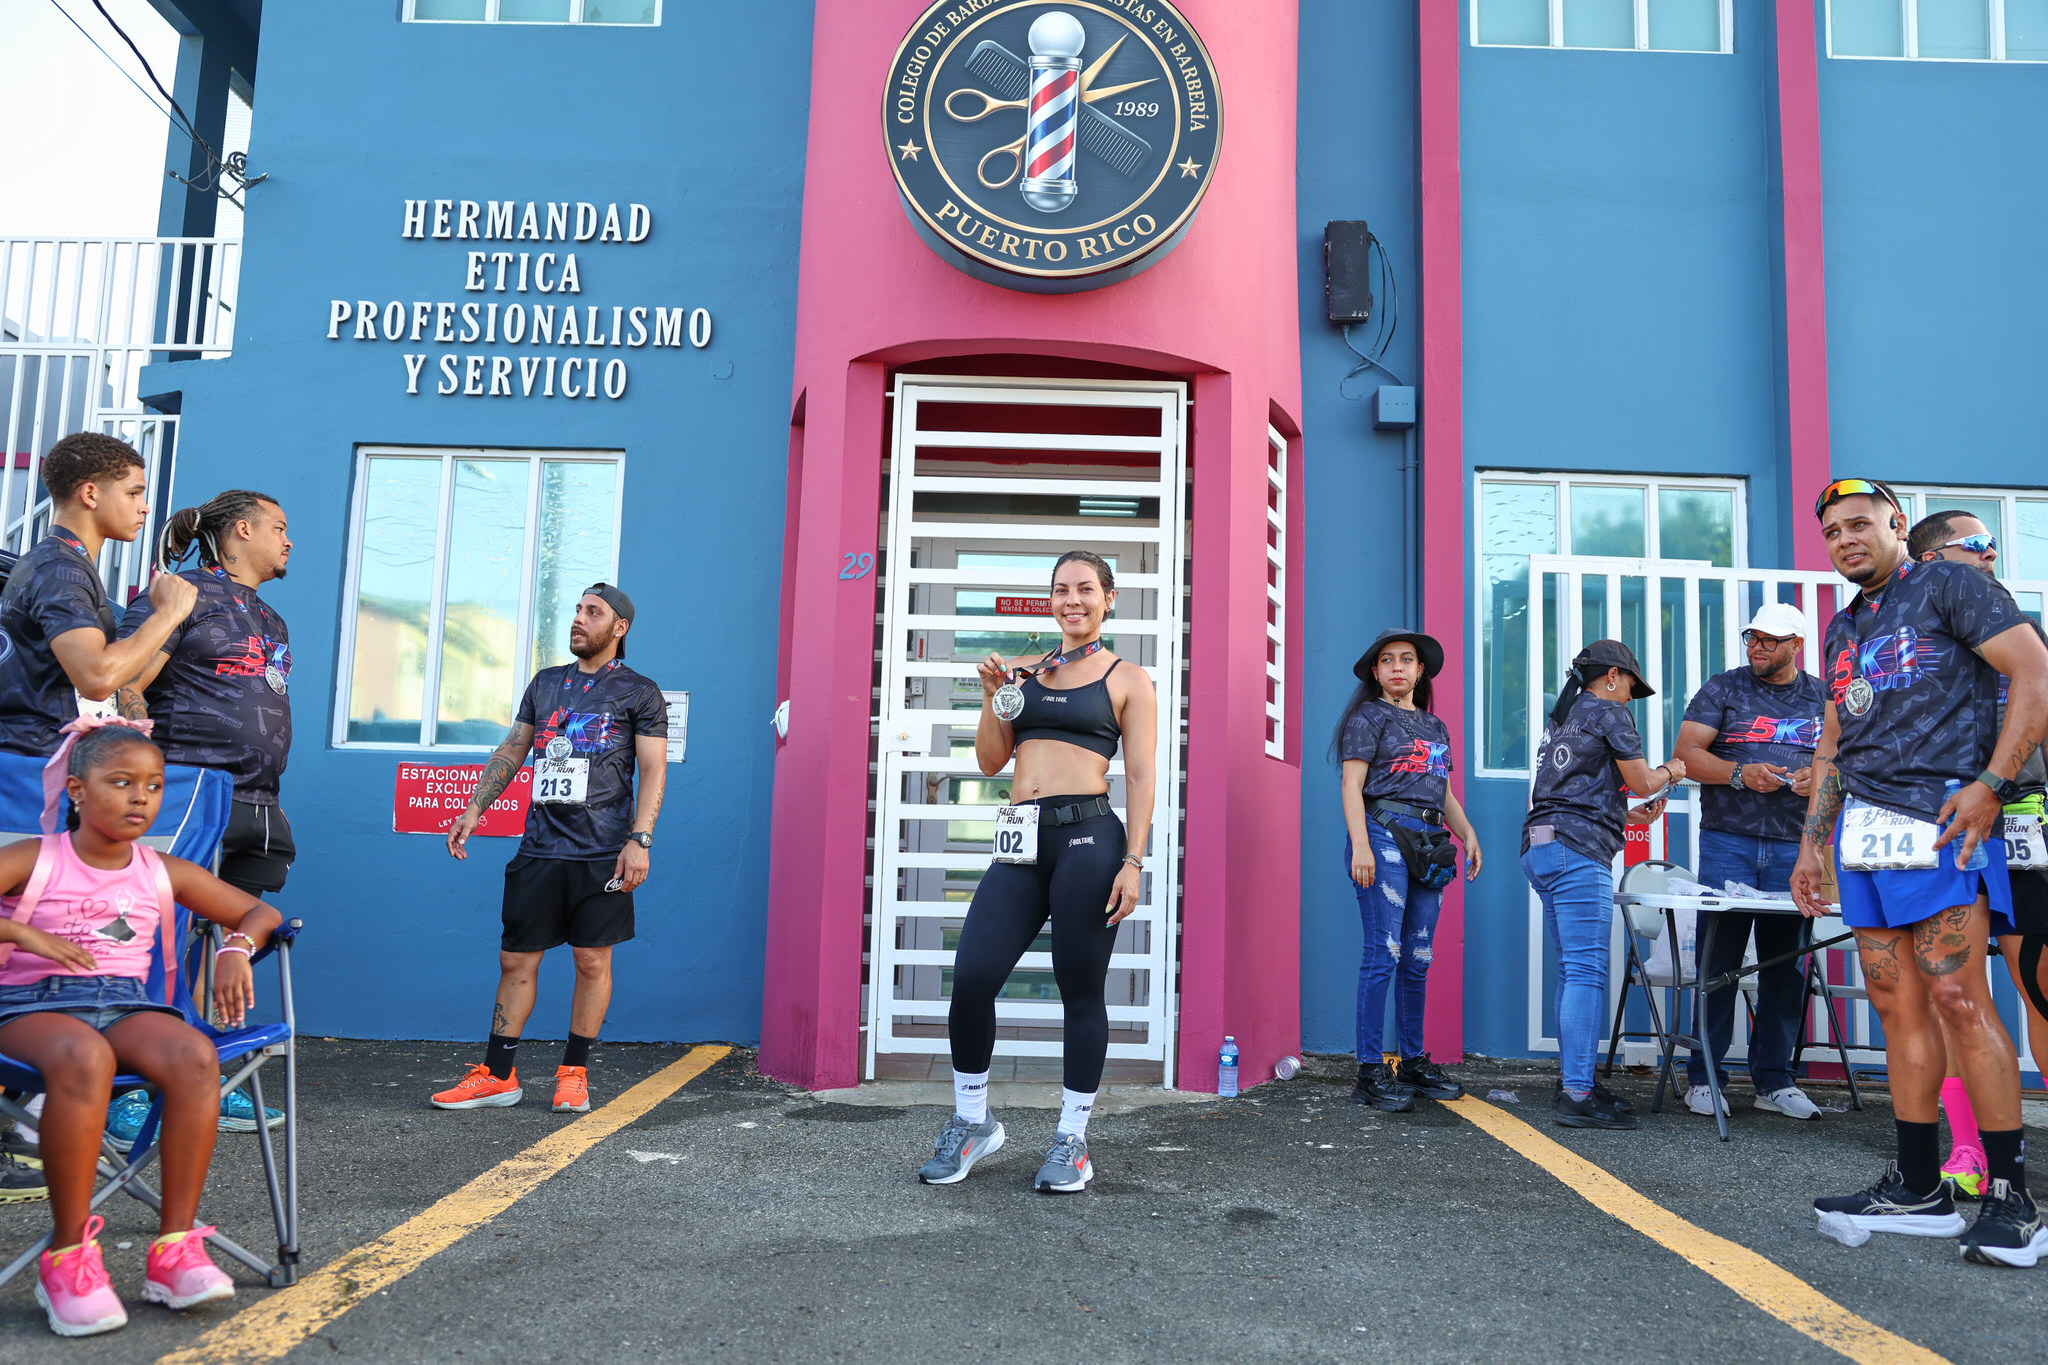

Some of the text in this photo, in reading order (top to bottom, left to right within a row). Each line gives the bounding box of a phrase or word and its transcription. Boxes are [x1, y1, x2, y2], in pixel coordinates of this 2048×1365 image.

[897, 45, 932, 124] COLEGIO
[924, 21, 951, 47] DE
[1151, 18, 1179, 44] EN
[1169, 42, 1210, 132] BARBERÍA
[1113, 101, 1159, 118] 1989
[402, 199, 652, 243] HERMANDAD
[934, 199, 1157, 262] PUERTO RICO
[464, 251, 582, 293] ETICA
[326, 299, 712, 349] PROFESIONALISMO
[403, 353, 628, 399] Y SERVICIO
[838, 552, 874, 580] 29
[1014, 599, 1023, 607] SE
[1026, 599, 1052, 607] PERMIT
[1745, 715, 1812, 743] 5K
[1409, 738, 1449, 769] 5K
[401, 768, 530, 783] ESTACIONATO
[1389, 762, 1428, 774] FADE
[1433, 766, 1449, 780] RU
[426, 782, 479, 795] EXCLUS
[540, 778, 572, 797] 213
[409, 796, 439, 808] PARA
[999, 807, 1018, 817] FADE
[438, 818, 453, 828] LEY
[1006, 816, 1024, 825] RUN
[1889, 816, 1915, 826] RUN
[2004, 825, 2029, 833] RUN
[1861, 832, 1915, 859] 214
[2004, 838, 2032, 861] 05
